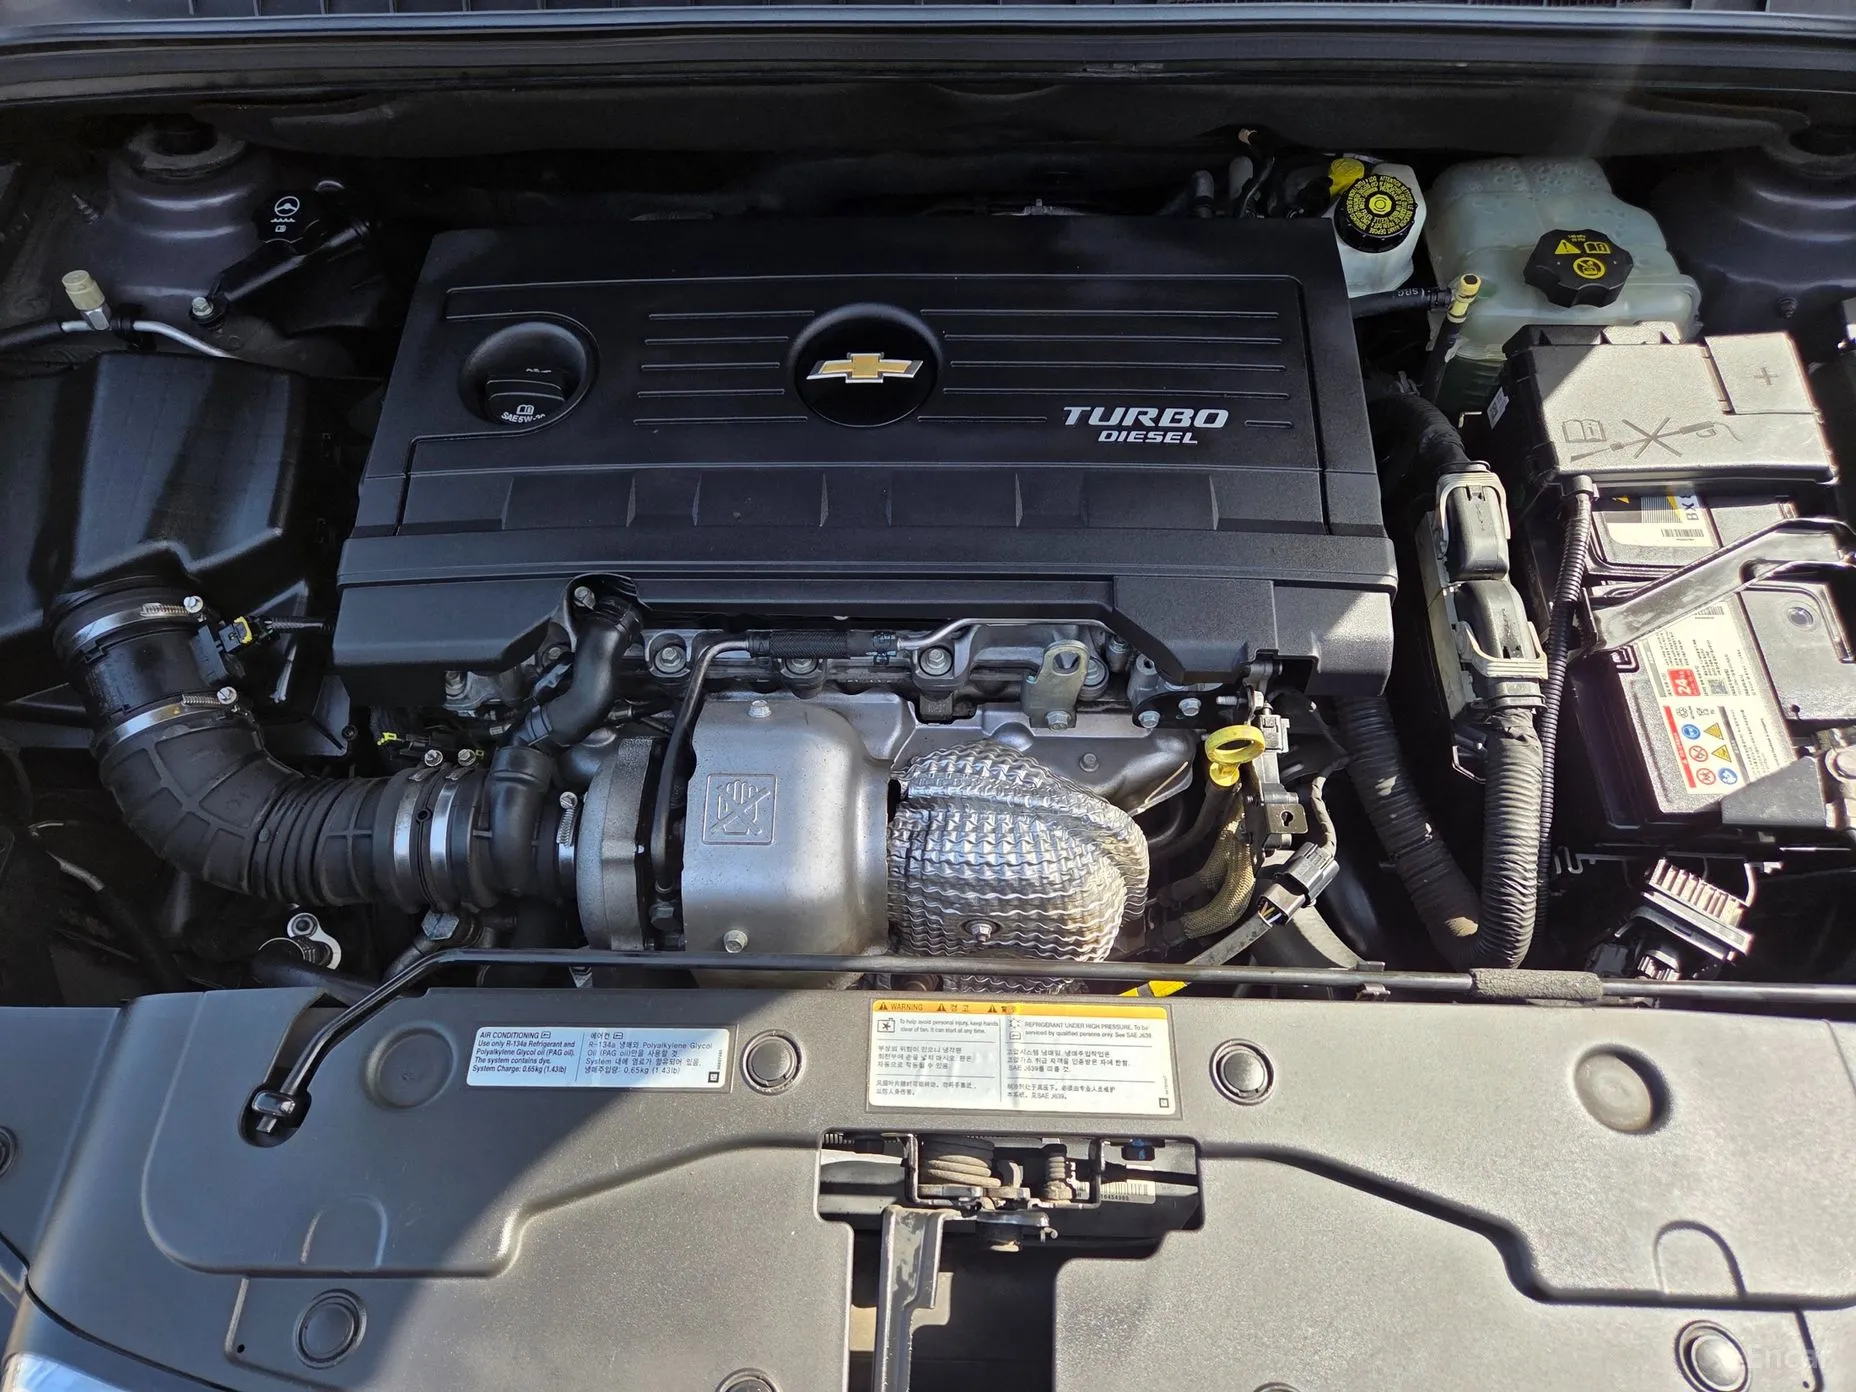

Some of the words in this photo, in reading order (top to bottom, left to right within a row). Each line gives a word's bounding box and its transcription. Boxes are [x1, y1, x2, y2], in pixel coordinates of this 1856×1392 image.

[1064, 406, 1229, 428] TURBO
[1098, 430, 1198, 444] DIESEL
[906, 1018, 917, 1026] help
[491, 1040, 504, 1048] only
[528, 1040, 562, 1049] Refrigerant
[642, 1042, 686, 1050] Polyalkylene
[690, 1042, 712, 1050] Glycol
[476, 1048, 516, 1056] Polyalkylene
[516, 1048, 536, 1056] Glycol
[536, 1048, 545, 1056] oil
[546, 1048, 562, 1056] (PAG
[600, 1050, 617, 1058] (PAG
[586, 1058, 612, 1066] System
[496, 1066, 522, 1074] Charge:
[522, 1066, 542, 1074] 0.65kg
[544, 1066, 567, 1074] (1.43lb)
